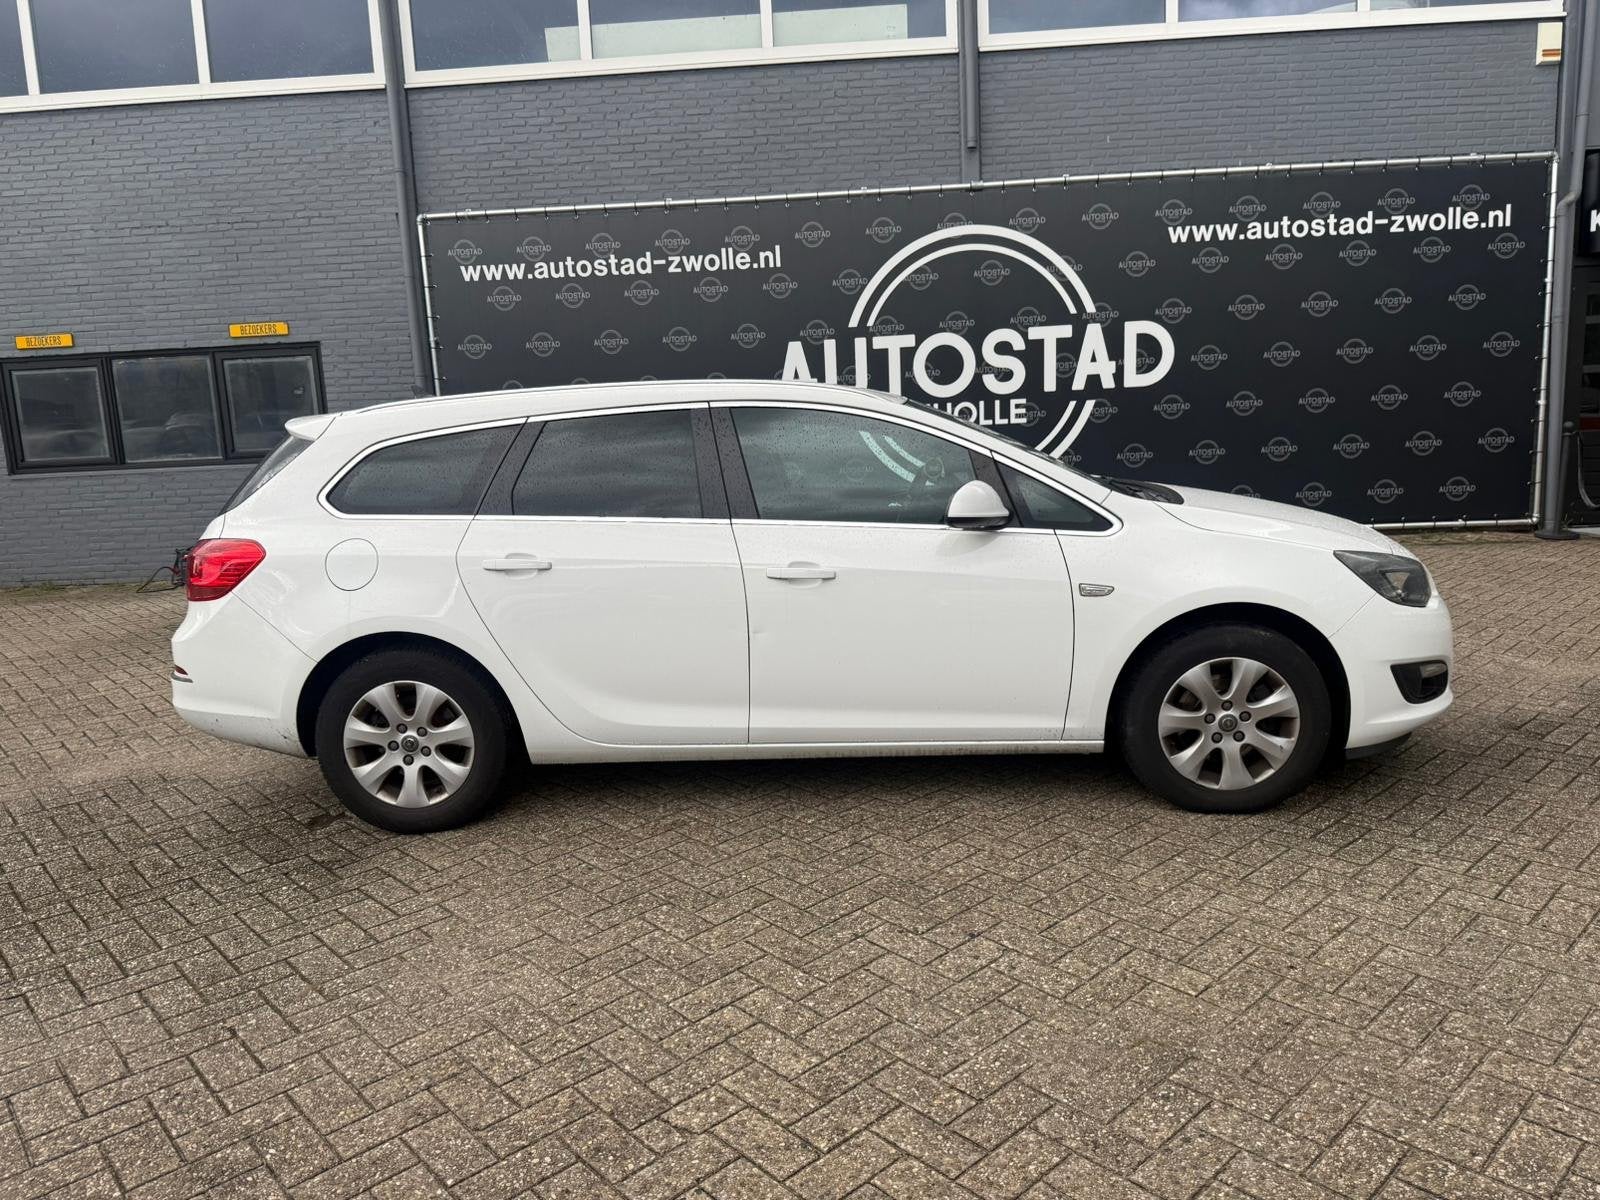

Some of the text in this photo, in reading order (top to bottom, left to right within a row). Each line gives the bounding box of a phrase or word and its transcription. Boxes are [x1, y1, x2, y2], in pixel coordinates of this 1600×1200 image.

[1377, 196, 1415, 206] AUTOSTAD
[1452, 192, 1490, 202] AUTOSTAD
[1229, 203, 1266, 214] AUTOSTAD
[1303, 199, 1341, 210] AUTOSTAD
[1082, 212, 1119, 222] AUTOSTAD
[1155, 207, 1193, 217] AUTOSTAD
[1009, 216, 1046, 226] AUTOSTAD
[1168, 204, 1511, 243] www.autostad-zwolle.nl
[795, 229, 831, 239] AUTOSTAD
[865, 225, 901, 235] AUTOSTAD
[655, 237, 690, 246] AUTOSTAD
[725, 233, 760, 243] AUTOSTAD
[517, 244, 551, 254] AUTOSTAD
[585, 241, 621, 250] AUTOSTAD
[1413, 244, 1451, 255] AUTOSTAD
[1488, 240, 1525, 251] AUTOSTAD
[448, 248, 482, 257] AUTOSTAD
[1265, 251, 1303, 262] AUTOSTAD
[1339, 247, 1377, 258] AUTOSTAD
[460, 245, 781, 282] www.autostad-zwolle.nl
[1118, 258, 1155, 268] AUTOSTAD
[1192, 254, 1229, 265] AUTOSTAD
[973, 268, 1010, 278] AUTOSTAD
[763, 281, 798, 292] AUTOSTAD
[832, 276, 868, 287] AUTOSTAD
[624, 288, 659, 297] AUTOSTAD
[693, 285, 728, 294] AUTOSTAD
[487, 294, 521, 303] AUTOSTAD
[555, 291, 591, 300] AUTOSTAD
[1375, 295, 1412, 306] AUTOSTAD
[1448, 292, 1486, 302] AUTOSTAD
[1228, 303, 1265, 313] AUTOSTAD
[1301, 299, 1338, 310] AUTOSTAD
[1082, 309, 1118, 320] AUTOSTAD
[1155, 306, 1192, 317] AUTOSTAD
[939, 318, 975, 328] AUTOSTAD
[1010, 314, 1046, 324] AUTOSTAD
[240, 322, 277, 336] BEZOEKERS
[800, 327, 835, 337] AUTOSTAD
[869, 322, 905, 333] AUTOSTAD
[662, 334, 697, 344] AUTOSTAD
[731, 331, 766, 340] AUTOSTAD
[26, 335, 62, 347] BEZOEKERS
[525, 339, 560, 349] AUTOSTAD
[594, 337, 629, 346] AUTOSTAD
[1483, 338, 1520, 349] AUTOSTAD
[458, 342, 492, 351] AUTOSTAD
[1336, 345, 1373, 356] AUTOSTAD
[1409, 342, 1447, 352] AUTOSTAD
[781, 320, 1175, 398] AUTOSTAD
[1191, 351, 1228, 362] AUTOSTAD
[1264, 349, 1300, 359] AUTOSTAD
[1371, 392, 1408, 402] AUTOSTAD
[1444, 389, 1481, 399] AUTOSTAD
[1226, 398, 1263, 409] AUTOSTAD
[1298, 395, 1336, 406] AUTOSTAD
[1154, 402, 1190, 412] AUTOSTAD
[1405, 438, 1442, 448] AUTOSTAD
[1478, 435, 1514, 445] AUTOSTAD
[1261, 444, 1298, 455] AUTOSTAD
[1333, 440, 1370, 451] AUTOSTAD
[1117, 450, 1153, 460] AUTOSTAD
[1189, 447, 1225, 457] AUTOSTAD
[1296, 488, 1332, 499] AUTOSTAD
[1367, 486, 1404, 495] AUTOSTAD
[1439, 483, 1476, 494] AUTOSTAD
